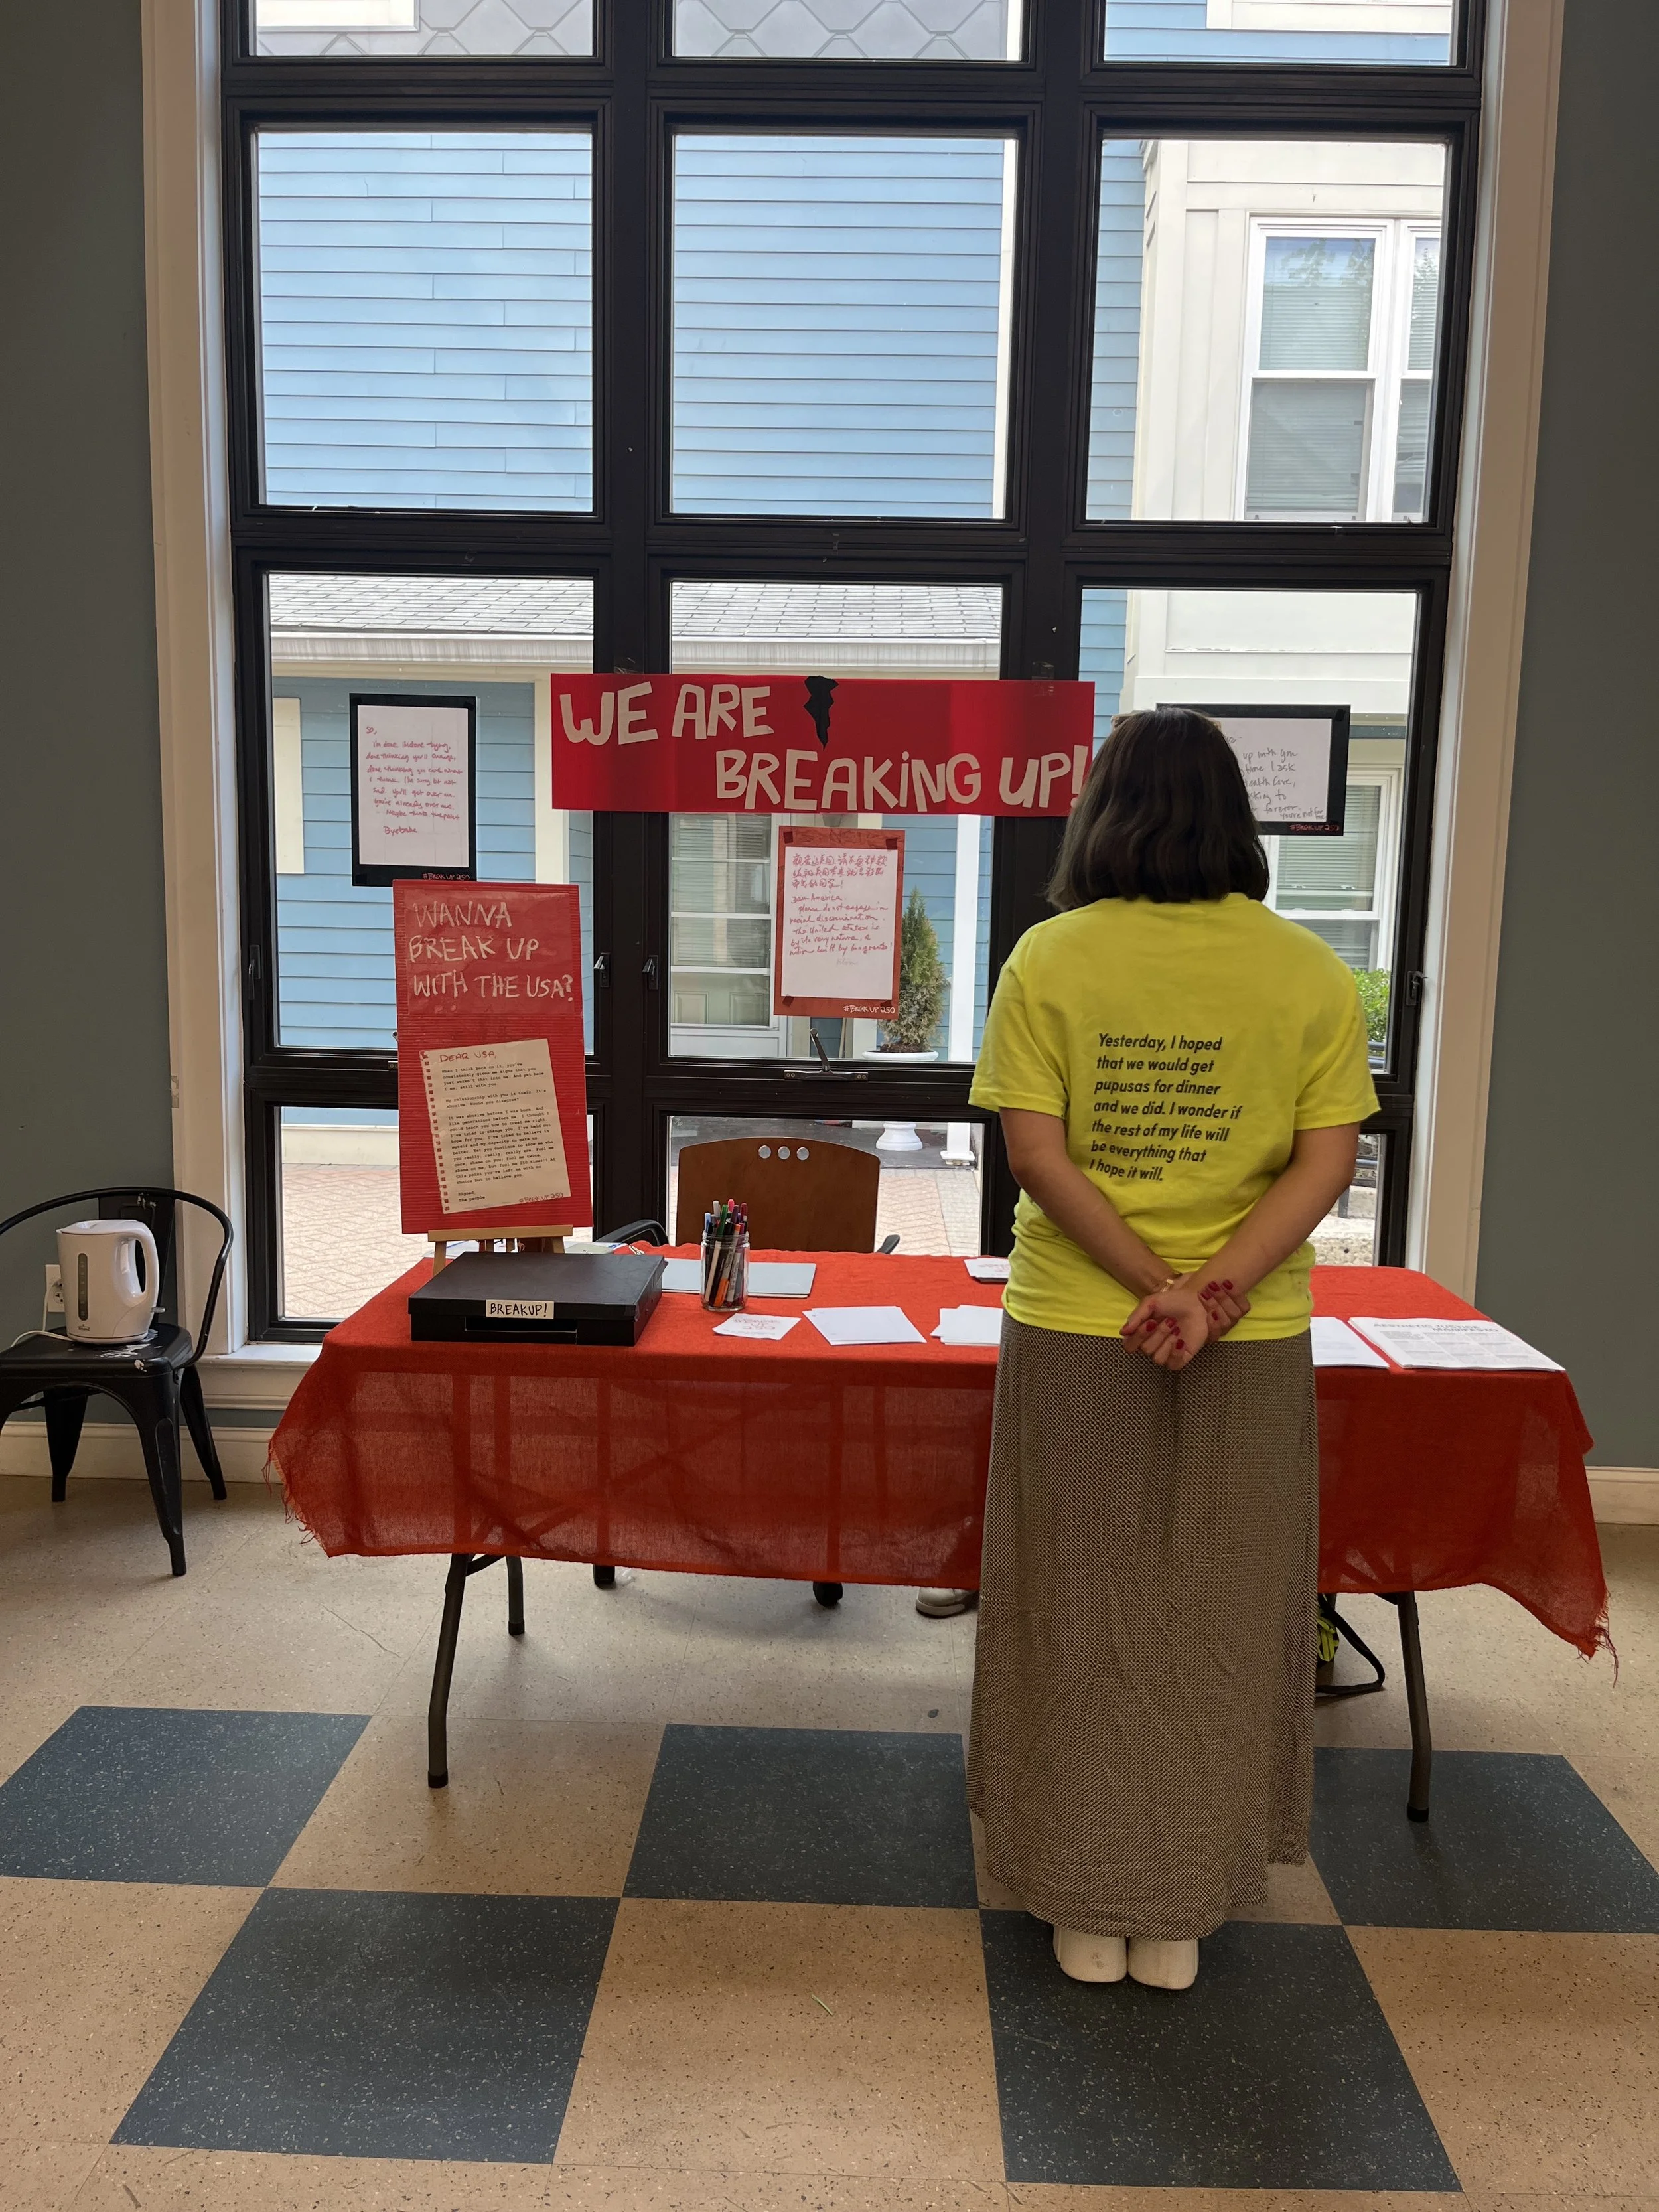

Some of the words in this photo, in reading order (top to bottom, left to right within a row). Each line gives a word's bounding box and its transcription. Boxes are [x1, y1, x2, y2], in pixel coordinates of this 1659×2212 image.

[560, 682, 659, 746] WE
[671, 685, 774, 739] ARE
[1243, 752, 1253, 763] up
[1258, 747, 1276, 759] with
[1280, 749, 1298, 763] you
[998, 744, 1090, 810] UP!
[1274, 789, 1287, 800] to
[413, 901, 512, 928] WANNA
[409, 935, 496, 962] BREAK
[506, 938, 540, 960] UP
[838, 944, 848, 957] by
[413, 969, 468, 999] WITH
[473, 972, 520, 998] THE
[526, 974, 573, 1001] USA?
[1098, 1033, 1166, 1052] Yesterday,
[1170, 1035, 1176, 1049] I
[1179, 1035, 1223, 1053] hoped
[440, 1053, 469, 1062] DEAR
[1096, 1055, 1123, 1070] that
[1127, 1061, 1144, 1070] we
[1148, 1057, 1189, 1071] would
[1190, 1060, 1214, 1075] get
[1094, 1080, 1150, 1095] pupusas
[1153, 1079, 1174, 1093] for
[1175, 1080, 1221, 1095] dinner
[1094, 1100, 1119, 1112] and
[1121, 1104, 1139, 1114] we
[1141, 1101, 1165, 1115] did.
[1169, 1102, 1176, 1115] I
[1177, 1103, 1229, 1118] wonder
[1230, 1105, 1243, 1119] if
[1091, 1119, 1112, 1132] the
[1114, 1124, 1140, 1136] rest
[1143, 1123, 1158, 1136] of
[1158, 1127, 1179, 1141] my
[1180, 1124, 1202, 1139] life
[1205, 1127, 1230, 1142] will
[1090, 1140, 1107, 1152] be
[1109, 1143, 1176, 1163] everything
[1178, 1147, 1206, 1162] that
[1088, 1159, 1096, 1169] I
[1096, 1161, 1125, 1178] hope
[1127, 1166, 1137, 1178] it
[1139, 1167, 1163, 1181] will.
[490, 1303, 547, 1317] BREAKUP!
